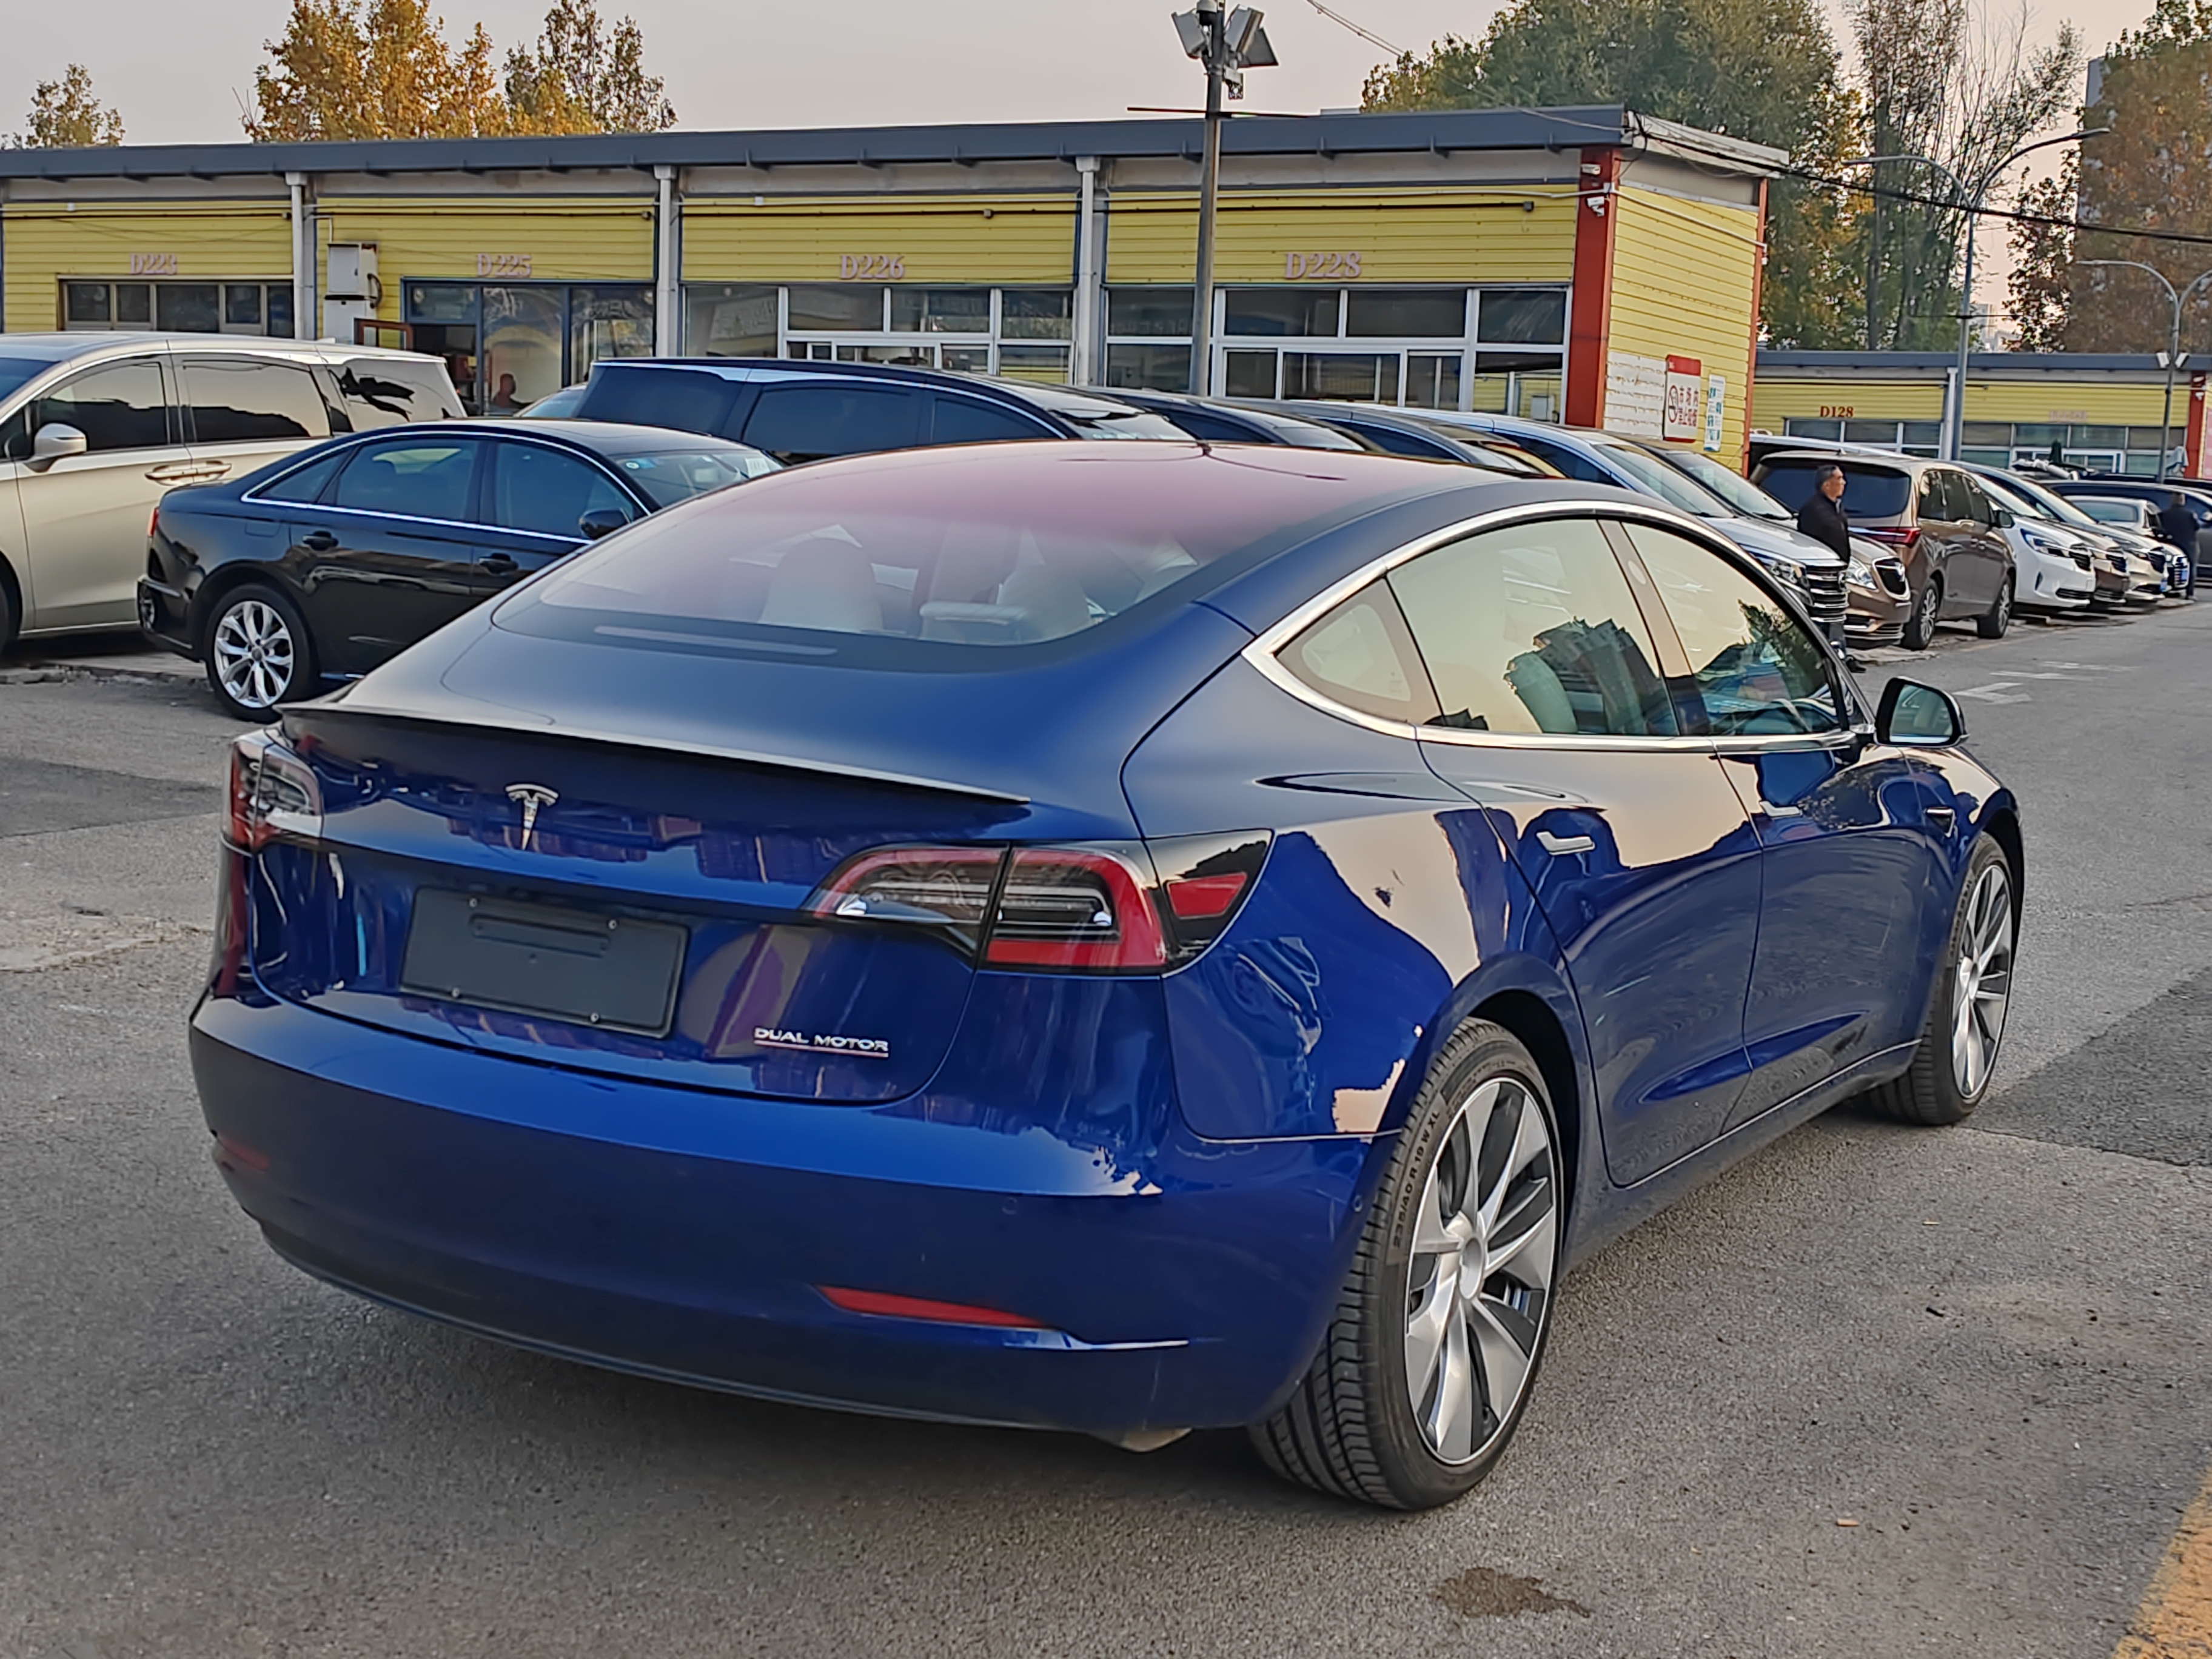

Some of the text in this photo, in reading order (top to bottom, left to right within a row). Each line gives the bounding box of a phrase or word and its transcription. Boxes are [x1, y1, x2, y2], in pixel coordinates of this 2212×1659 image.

[129, 253, 176, 275] D223
[477, 252, 532, 277] D225
[840, 254, 905, 279] D226
[1285, 251, 1361, 280] D228
[1820, 406, 1854, 417] D128
[754, 1027, 888, 1051] DUAL MOTOR
[1428, 1111, 1440, 1129] XL
